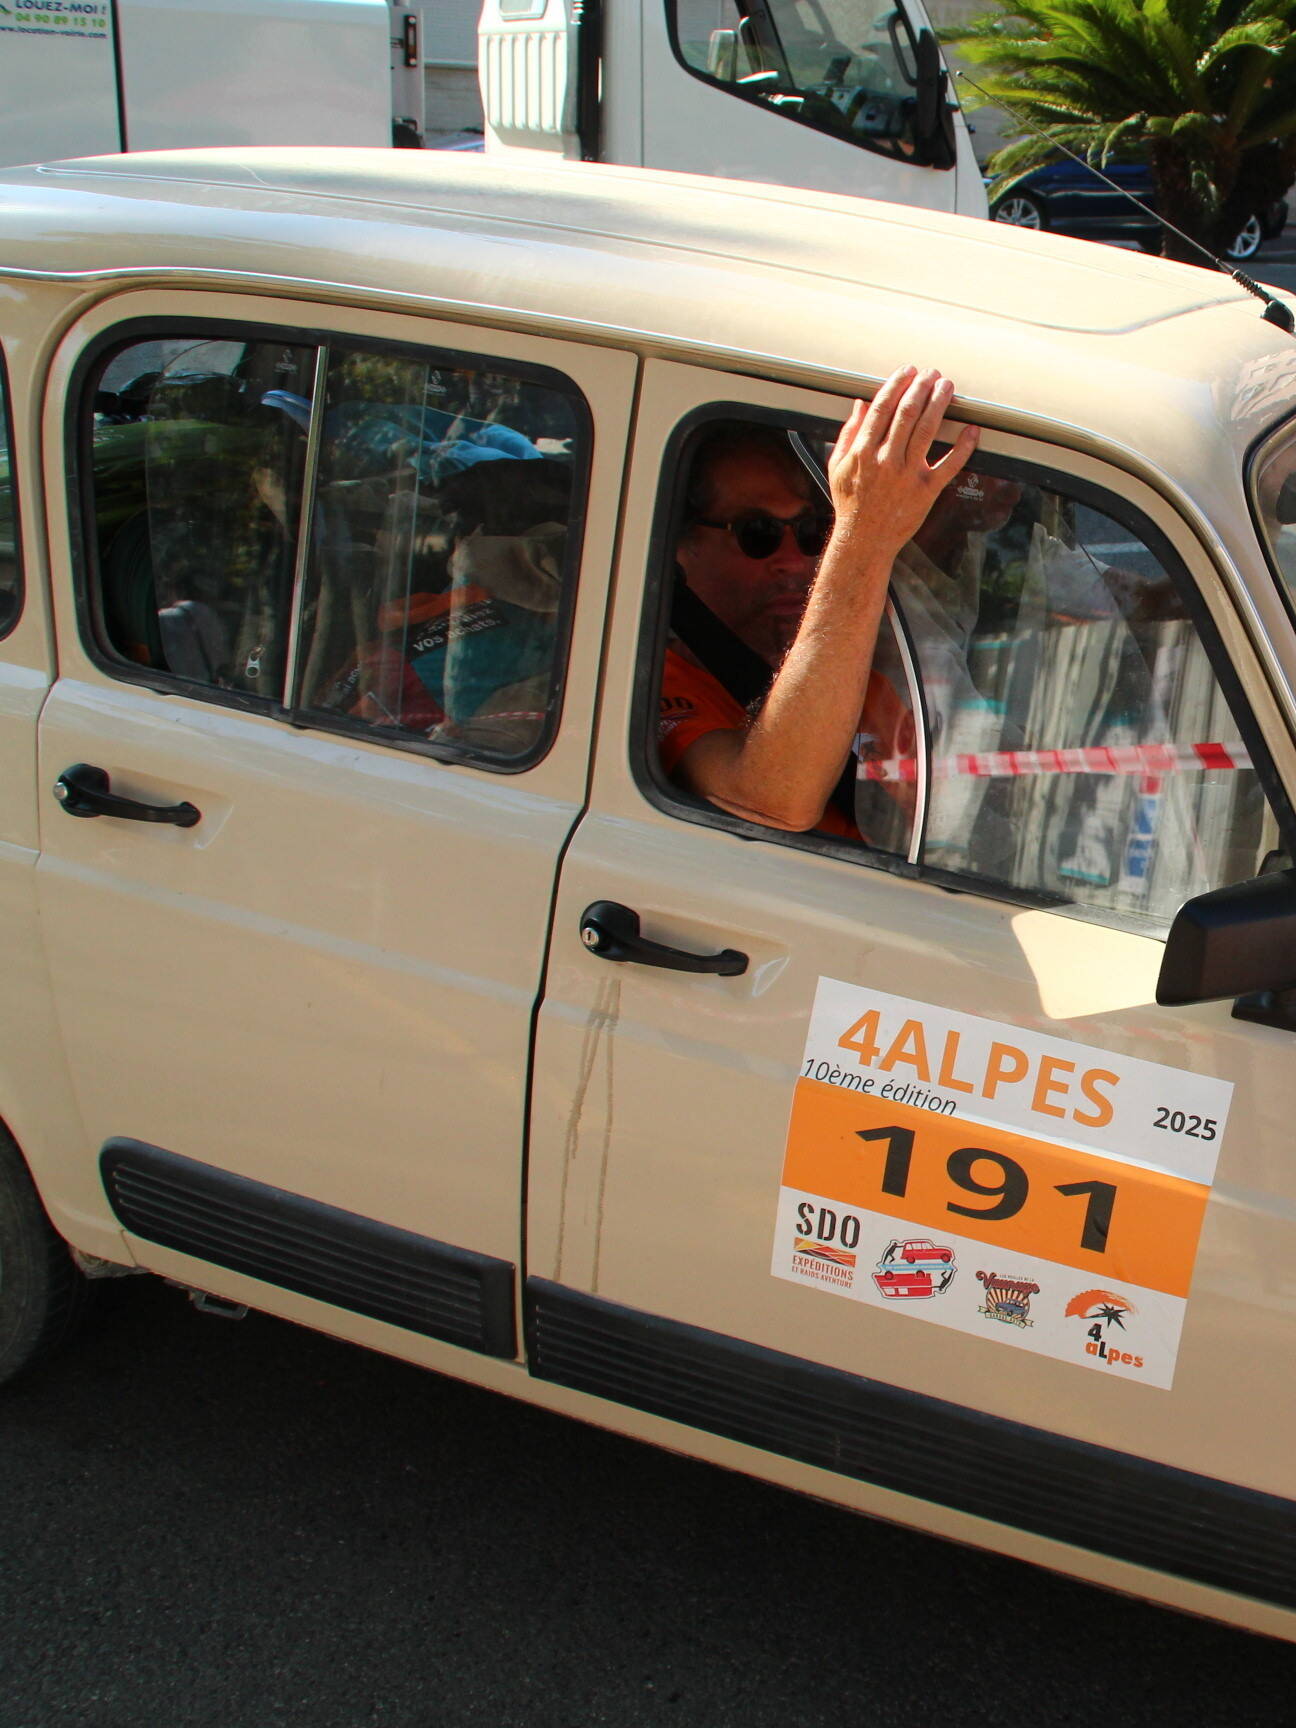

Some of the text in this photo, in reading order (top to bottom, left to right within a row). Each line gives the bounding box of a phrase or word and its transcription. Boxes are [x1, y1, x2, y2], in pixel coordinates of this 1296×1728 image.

[804, 1058, 957, 1116] 10ème édition
[838, 1009, 1121, 1128] 4ALPES
[1153, 1106, 1217, 1141] 2025
[854, 1126, 1117, 1253] 191
[796, 1202, 860, 1249] SDO
[792, 1255, 854, 1281] EXPÉDITIONS
[1087, 1323, 1102, 1342] 4
[1085, 1341, 1143, 1368] aLpes
